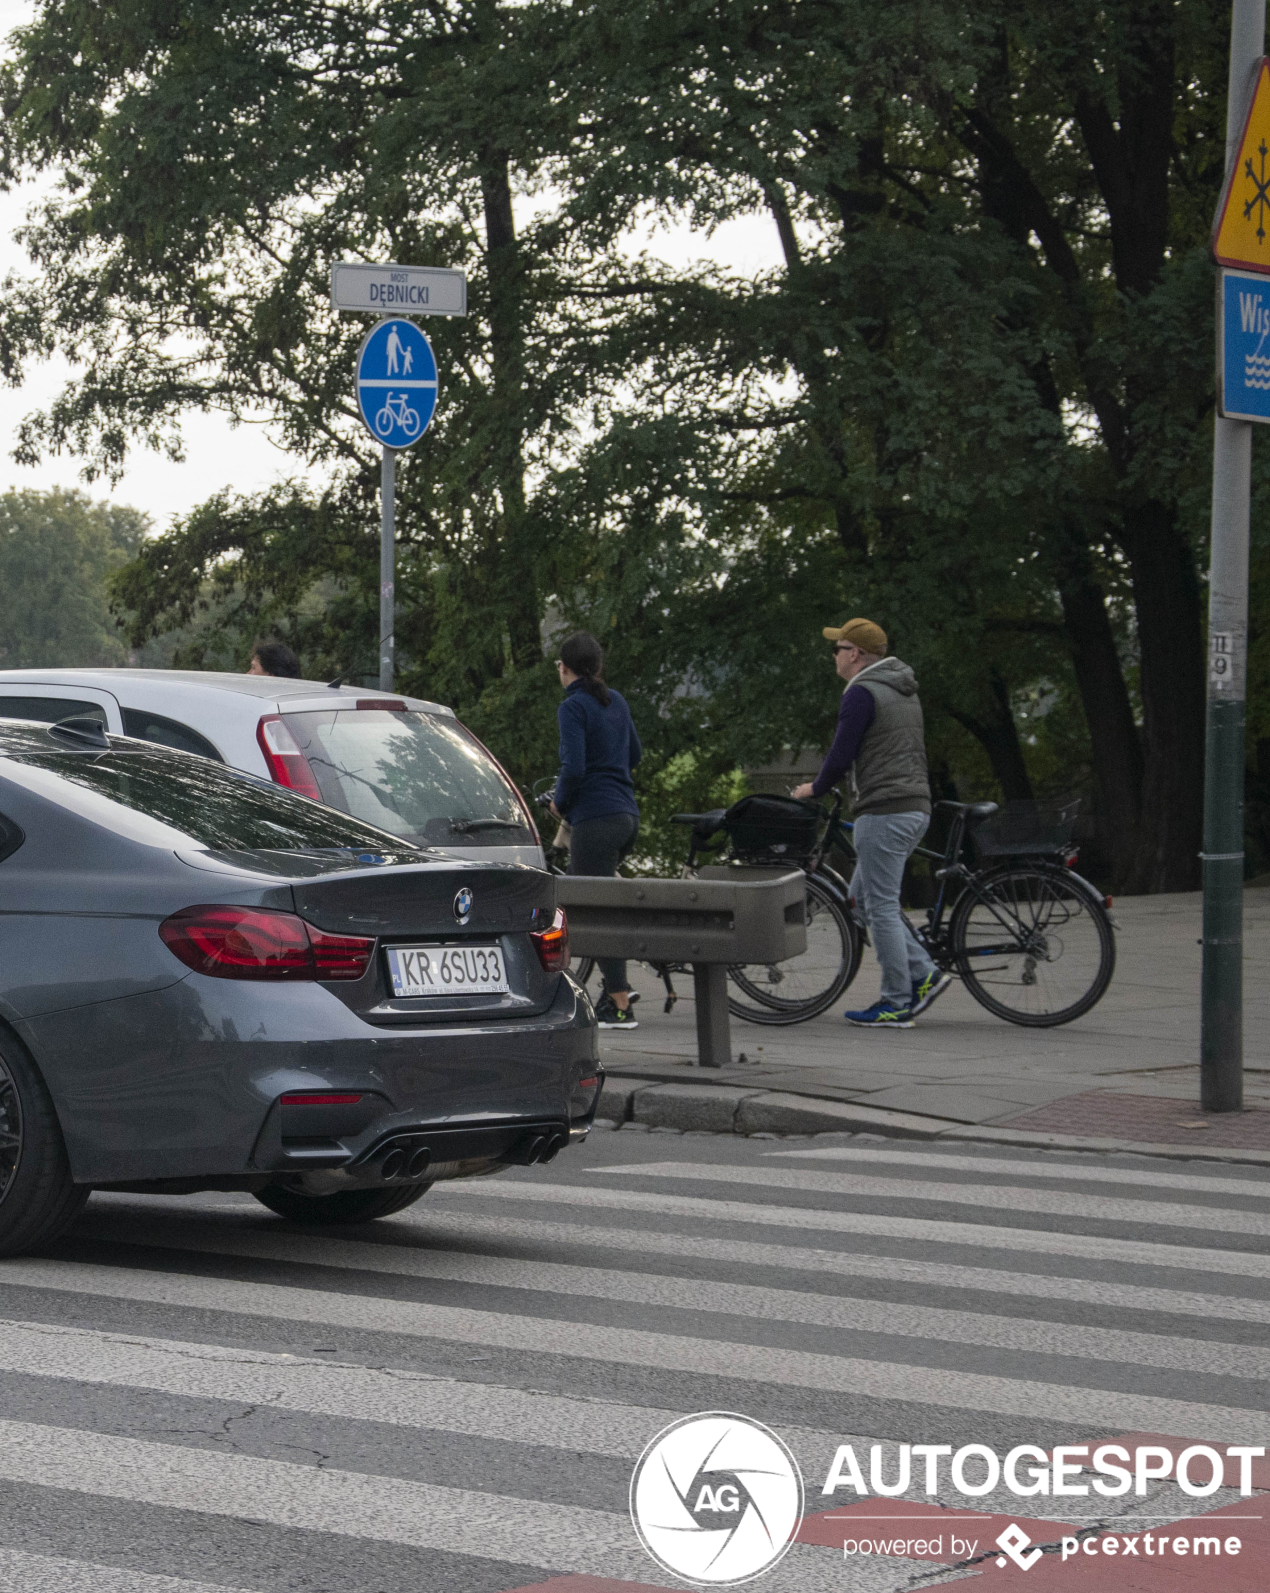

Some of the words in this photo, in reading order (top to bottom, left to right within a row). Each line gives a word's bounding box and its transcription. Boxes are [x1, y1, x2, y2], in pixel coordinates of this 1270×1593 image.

[390, 273, 409, 283] MOST
[369, 283, 430, 307] DĘBNICKI
[1212, 657, 1227, 675] 9
[401, 951, 434, 986] KR
[439, 949, 502, 984] 6SU33
[392, 974, 401, 984] PL
